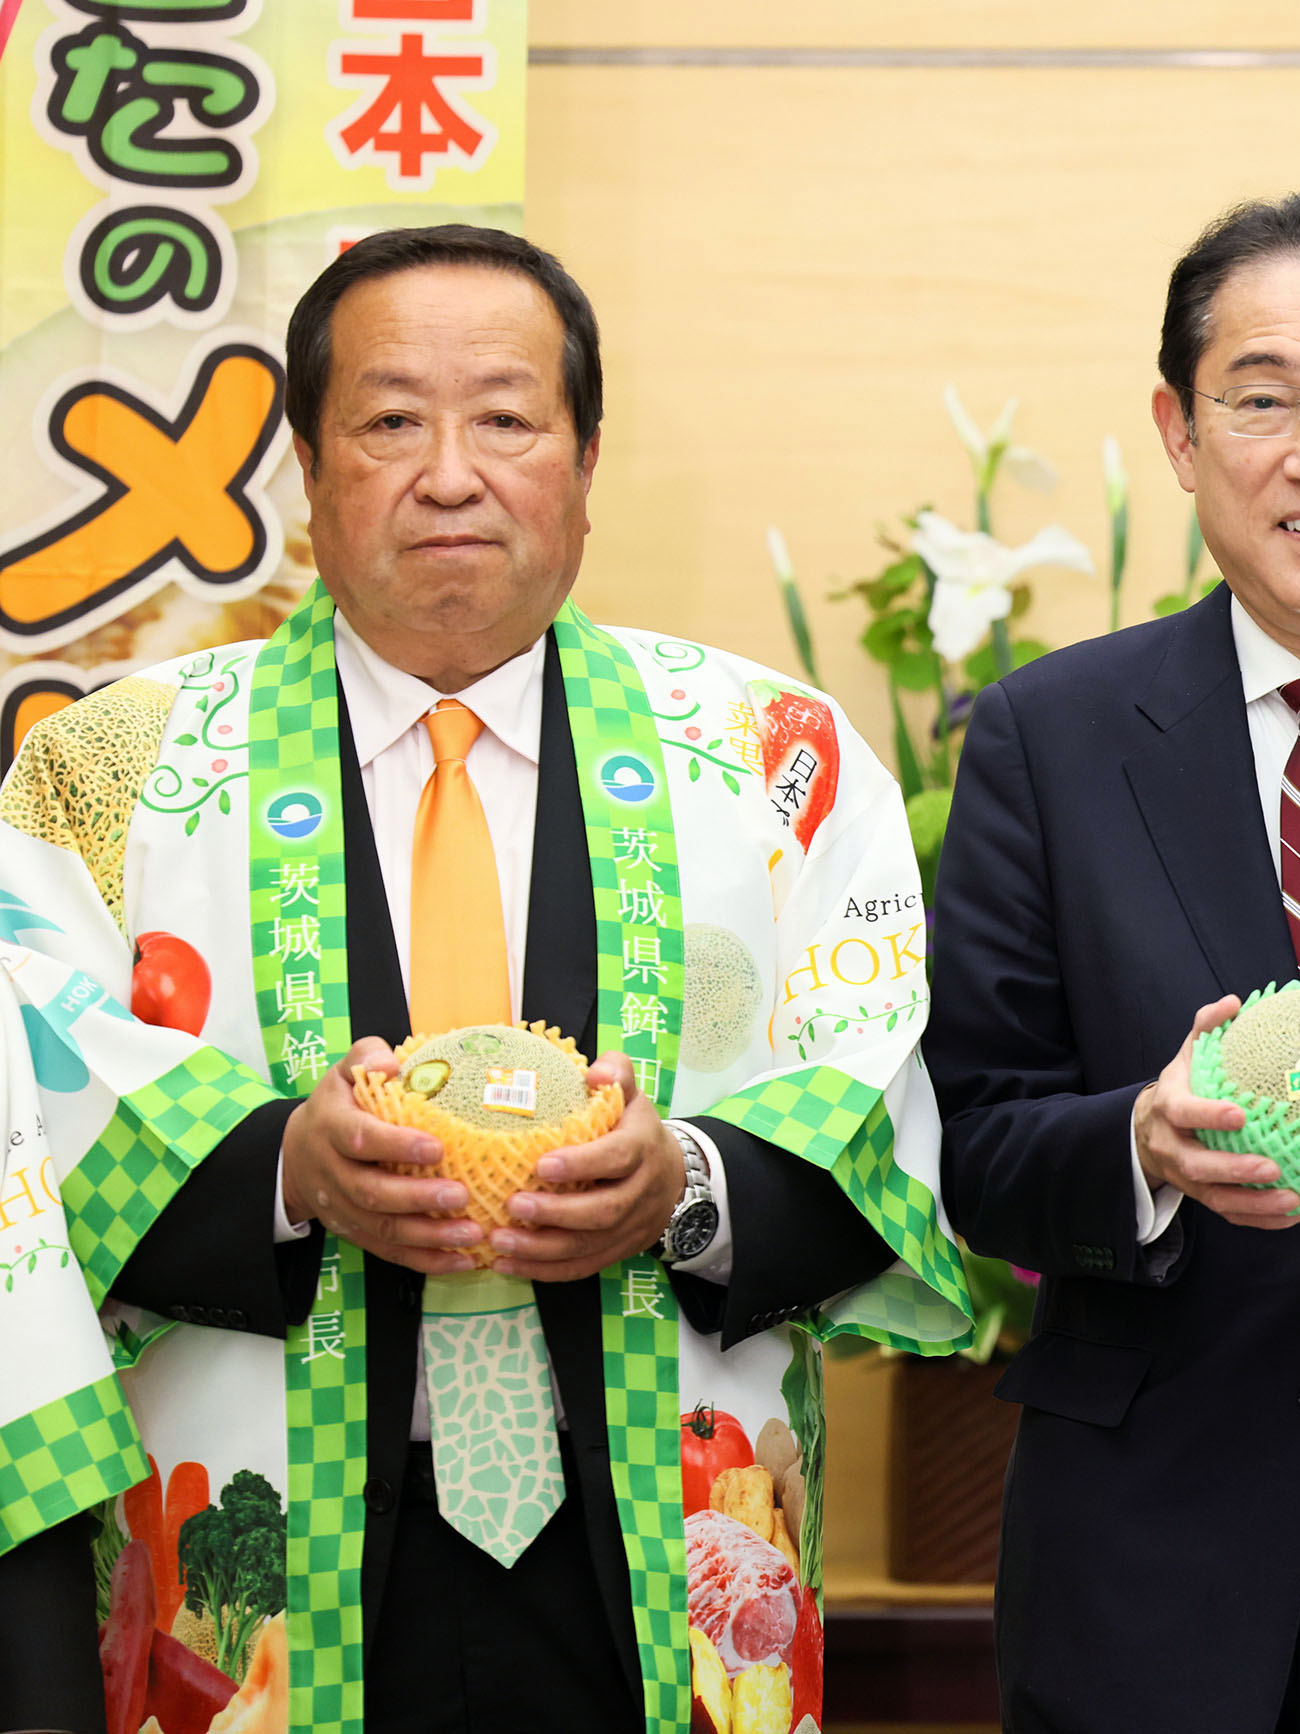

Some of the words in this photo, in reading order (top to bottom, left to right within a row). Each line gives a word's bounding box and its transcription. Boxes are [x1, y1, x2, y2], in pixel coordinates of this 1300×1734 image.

[339, 0, 484, 178] 本
[0, 0, 288, 788] たのメ
[843, 893, 923, 922] Agric
